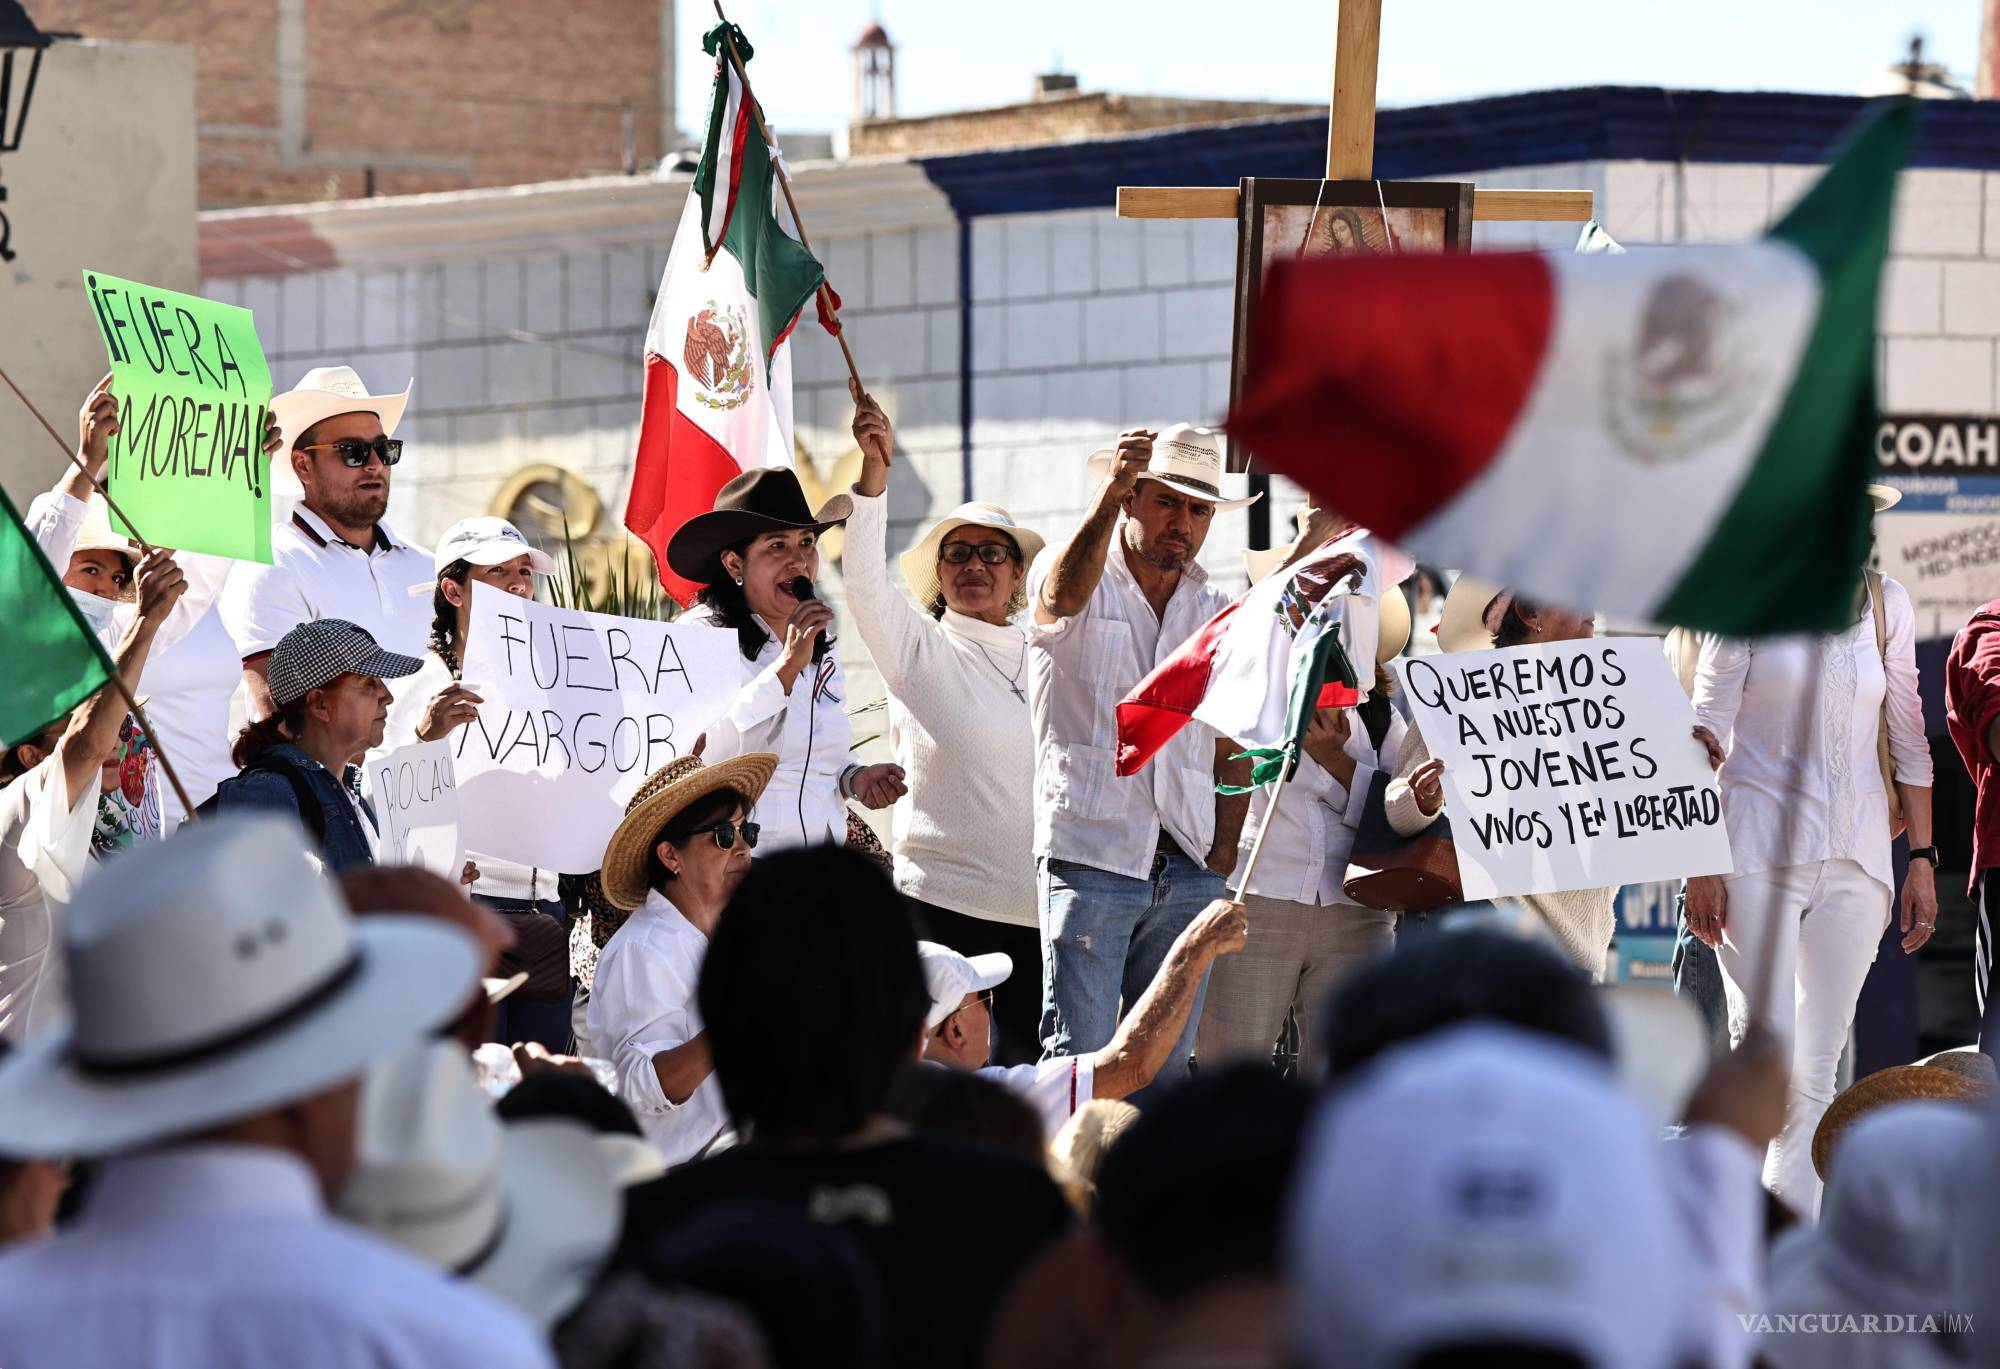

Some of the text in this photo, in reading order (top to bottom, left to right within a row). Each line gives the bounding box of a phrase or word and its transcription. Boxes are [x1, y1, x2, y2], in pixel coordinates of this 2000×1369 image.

[114, 392, 265, 498] MORENA!
[499, 615, 693, 693] FUERA
[1406, 648, 1627, 715] QUEREMOS
[1458, 694, 1625, 746] A NUESTOS
[1470, 737, 1658, 798] JOVENES
[1470, 807, 1553, 851] VIVOS
[1614, 785, 1720, 839] LIBERTAD
